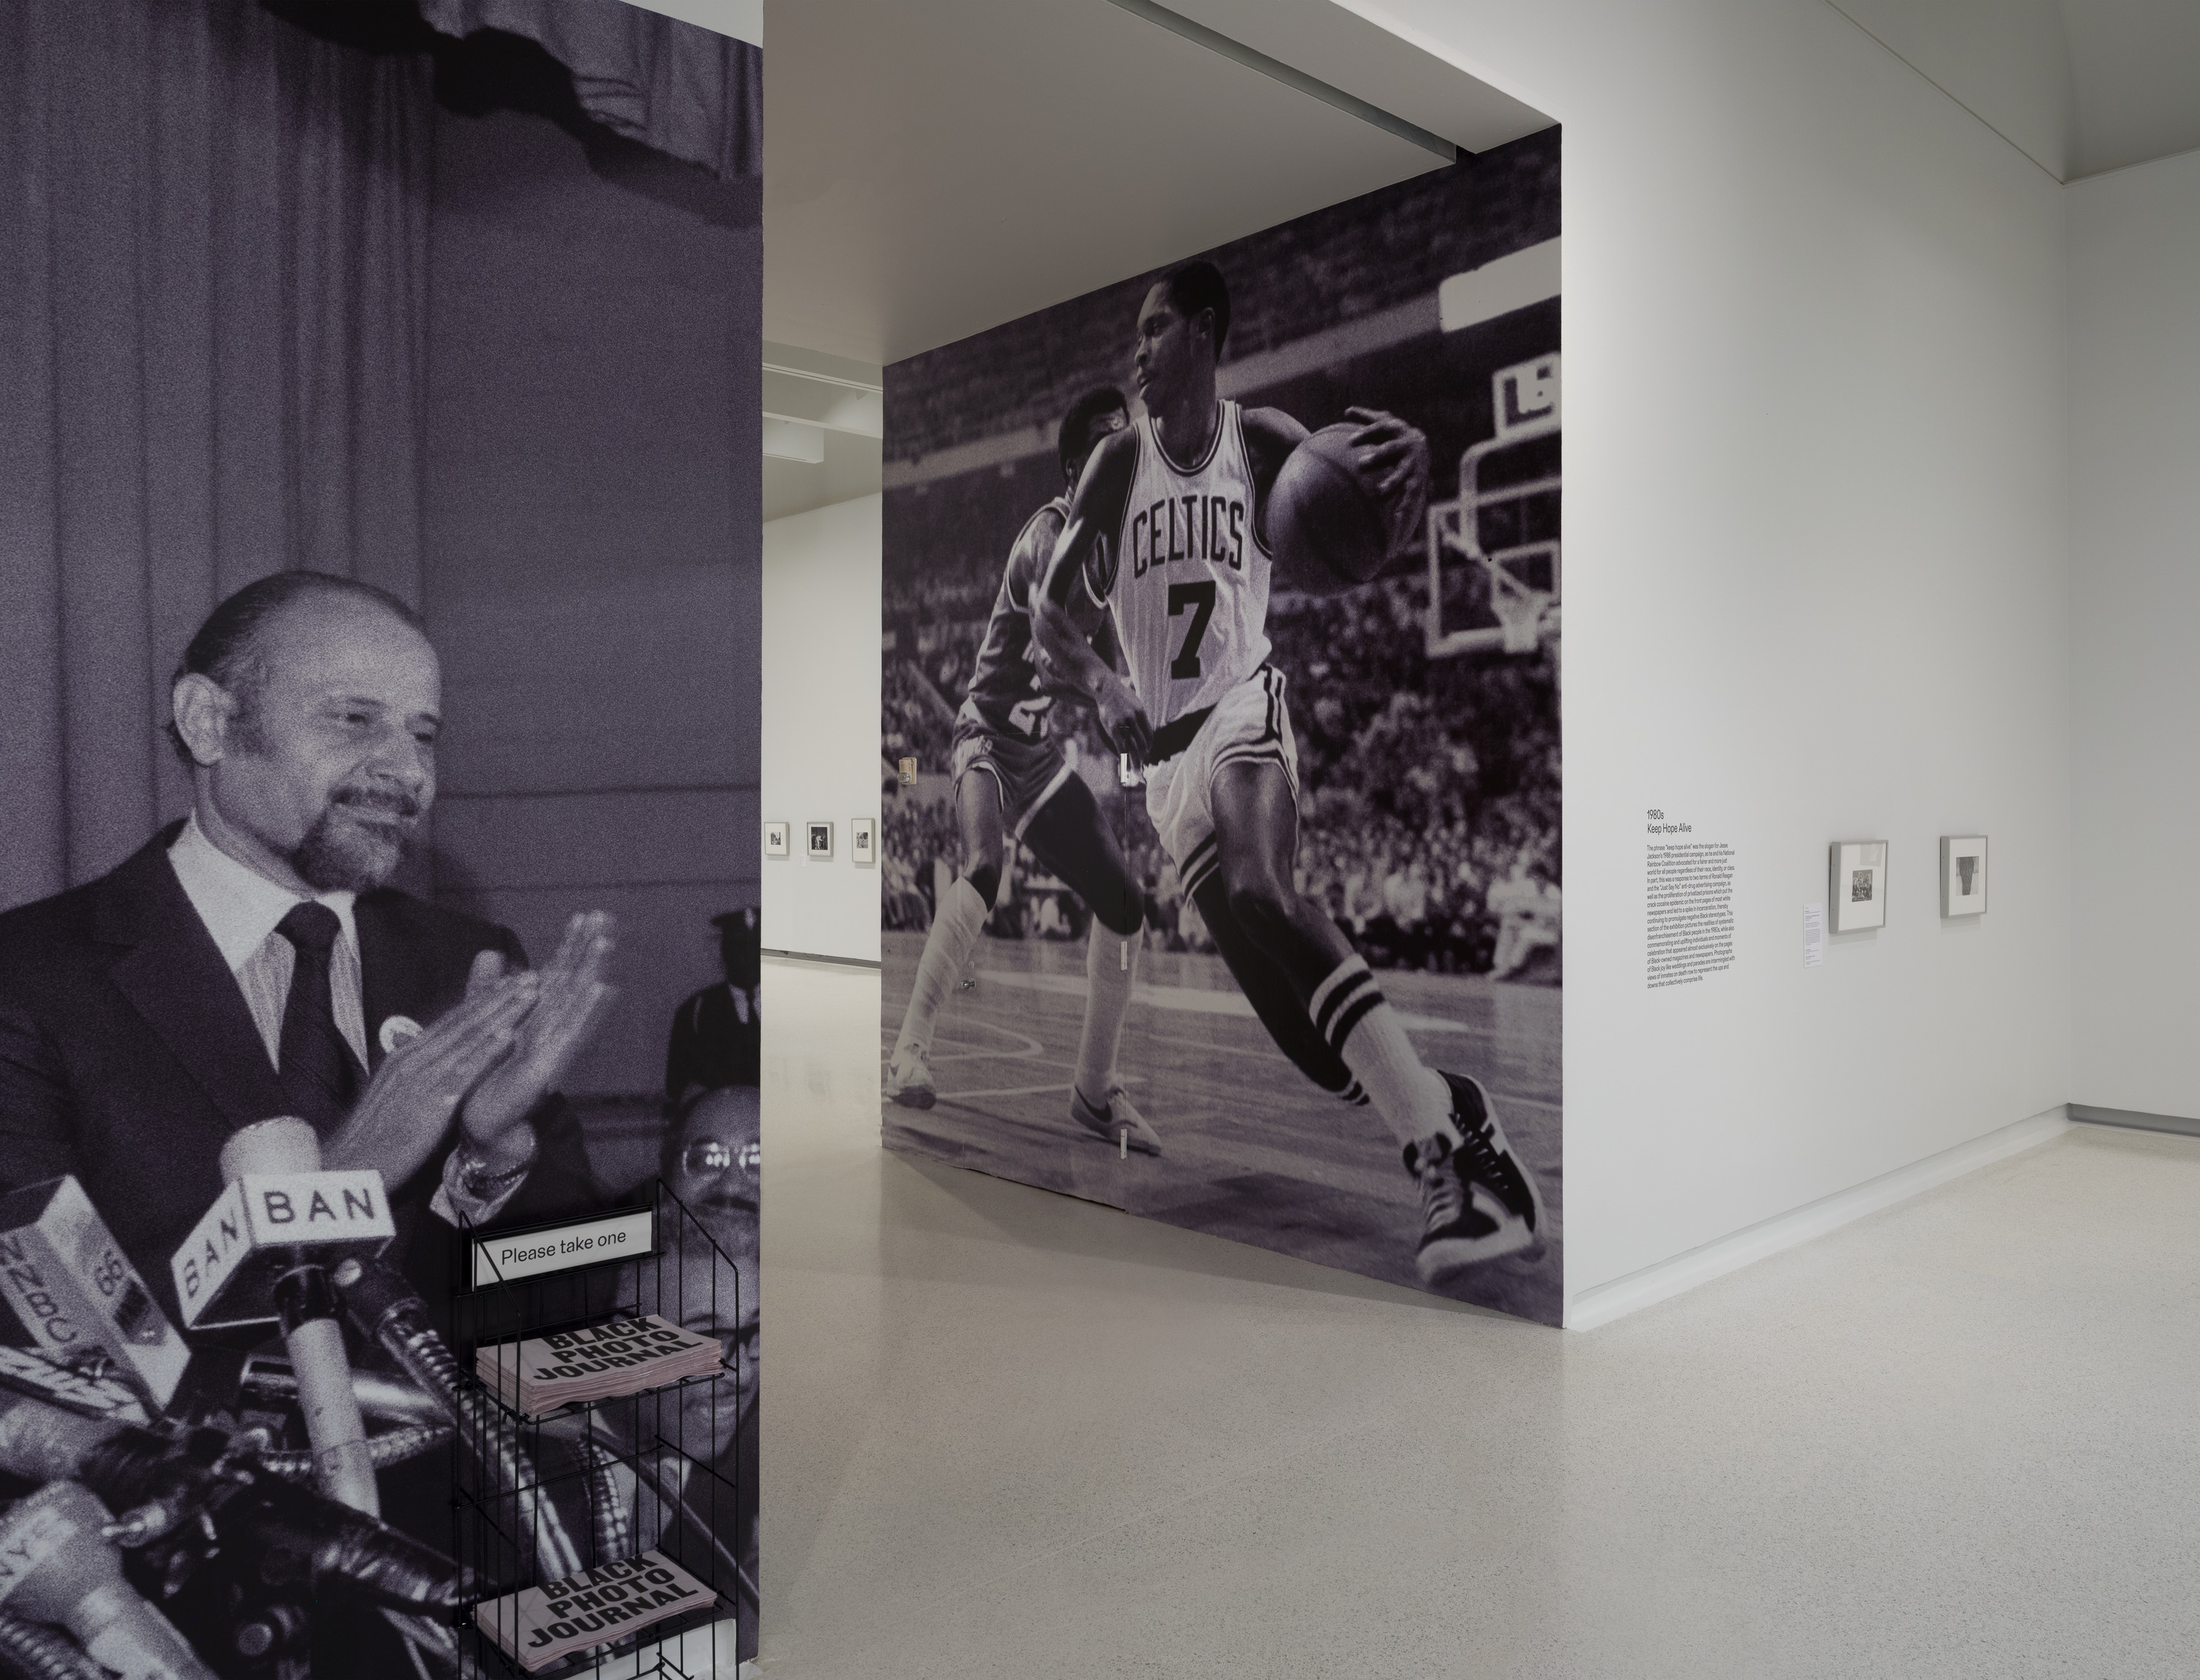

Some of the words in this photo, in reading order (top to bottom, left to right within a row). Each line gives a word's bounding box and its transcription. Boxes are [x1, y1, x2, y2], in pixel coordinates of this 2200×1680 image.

[1133, 495, 1244, 579] CELTICS
[1168, 580, 1216, 679] 7
[1647, 809, 1664, 820] 1980s
[1648, 823, 1662, 835] Keep
[1662, 823, 1678, 835] Hope
[1679, 823, 1692, 832] Alive
[1671, 851, 1689, 859] presidential
[1664, 892, 1683, 900] proliferation
[1687, 889, 1702, 898] privatized
[1670, 899, 1684, 907] epidemic
[1668, 915, 1686, 923] promulgate
[1719, 917, 1734, 925] systematic
[1647, 932, 1678, 940] disenfranchisement
[1692, 928, 1701, 936] people
[1647, 940, 1673, 948] commemorating
[1673, 946, 1687, 954] appeared
[1651, 955, 1672, 964] Black-owned
[1673, 954, 1688, 962] magazines
[1711, 955, 1728, 964] intermingled
[264, 1189, 374, 1224] BAN
[184, 1207, 238, 1299] BAN
[502, 1245, 555, 1265] Please
[560, 1236, 593, 1254] take
[598, 1232, 626, 1247] one
[542, 1317, 663, 1350] BLACK
[551, 1330, 680, 1363] PHOTO
[533, 1340, 704, 1380] JOURNAL
[539, 1553, 659, 1600] BLACK
[546, 1568, 675, 1619] PHOTO
[528, 1582, 699, 1648] JOURNAL
